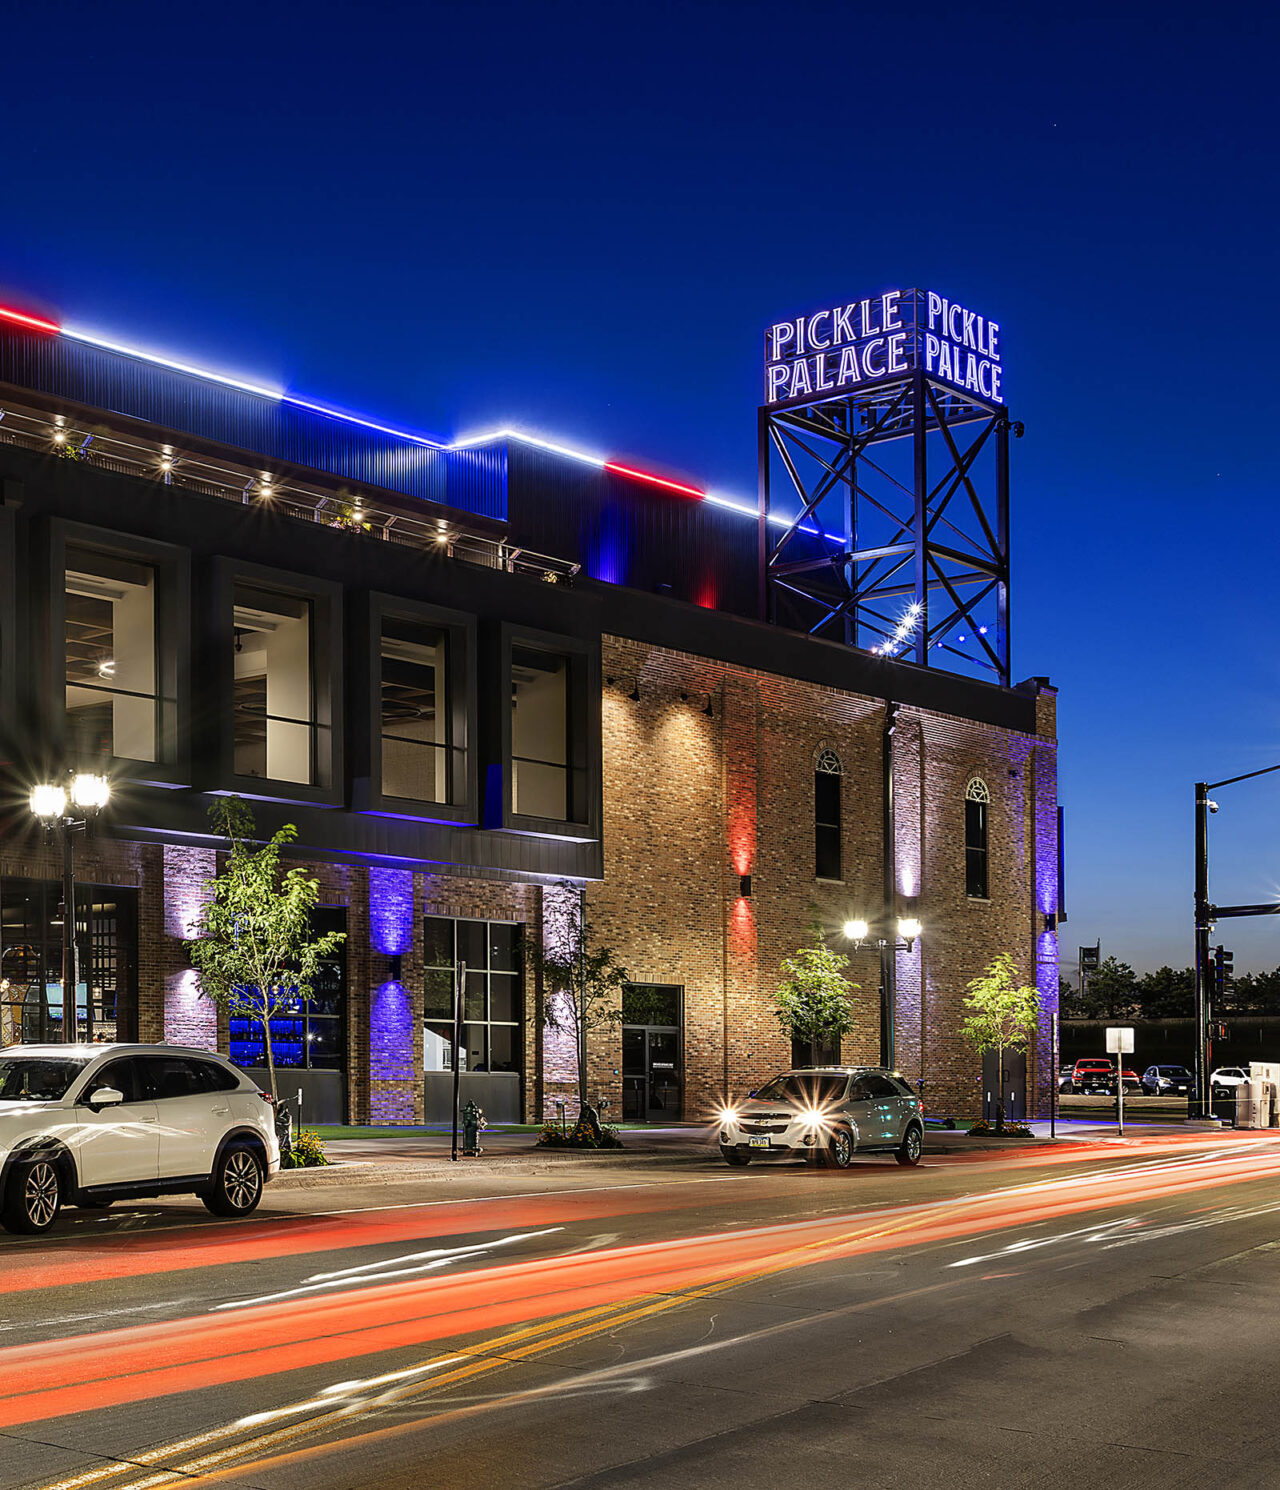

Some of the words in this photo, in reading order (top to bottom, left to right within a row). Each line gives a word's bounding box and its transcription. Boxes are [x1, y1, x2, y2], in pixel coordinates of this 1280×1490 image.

[772, 291, 903, 362] PICKLE
[928, 291, 1001, 362] PICKLE
[768, 332, 909, 403] PALACE
[925, 332, 1003, 403] PALACE
